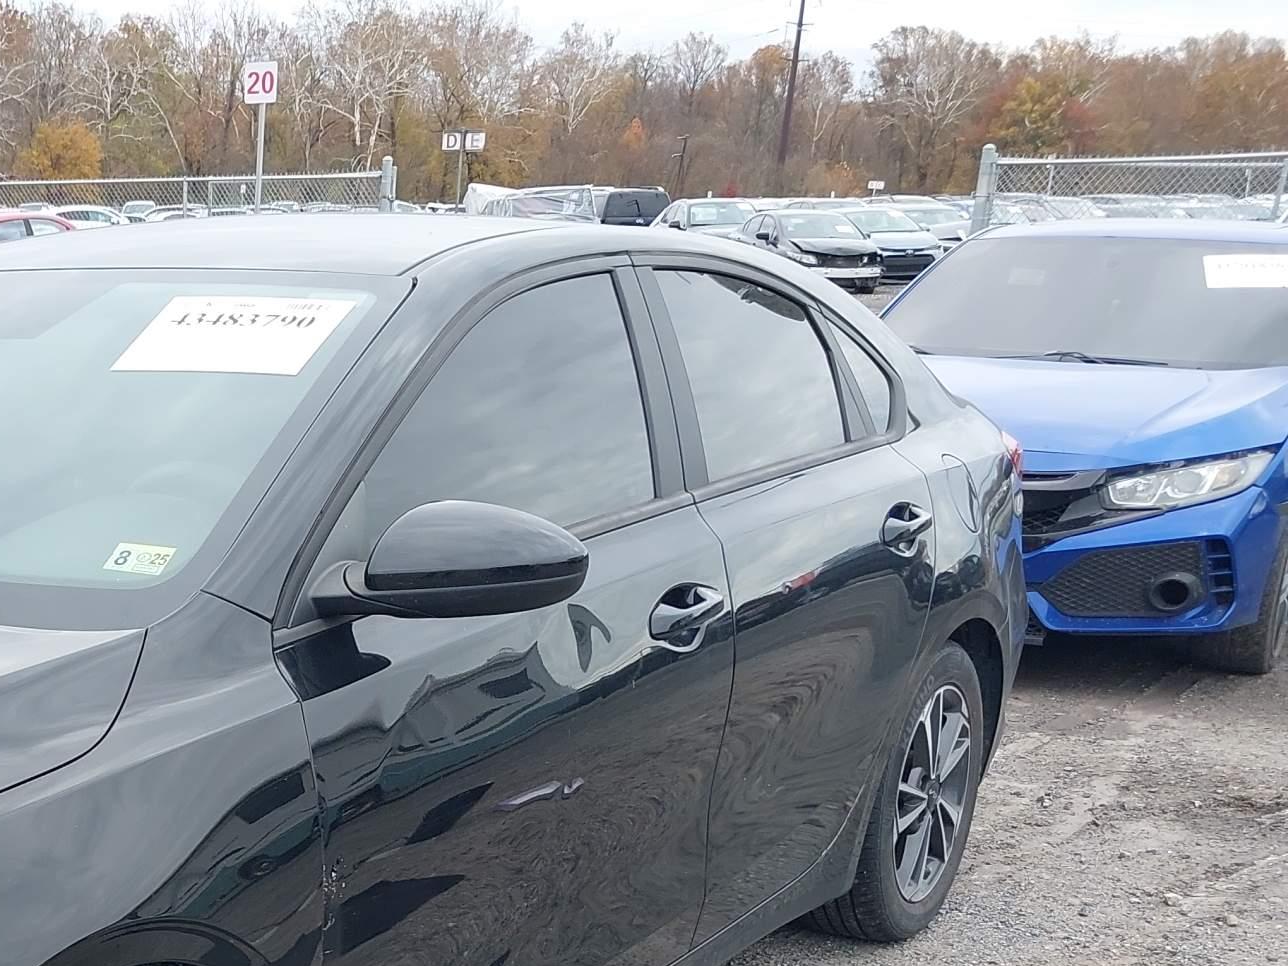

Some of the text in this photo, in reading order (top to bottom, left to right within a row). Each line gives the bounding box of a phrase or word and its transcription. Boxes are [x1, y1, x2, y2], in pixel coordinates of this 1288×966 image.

[247, 71, 274, 94] 20
[447, 134, 480, 148] D E
[171, 312, 316, 328] 43483790
[114, 550, 132, 566] 8
[150, 553, 170, 565] 25
